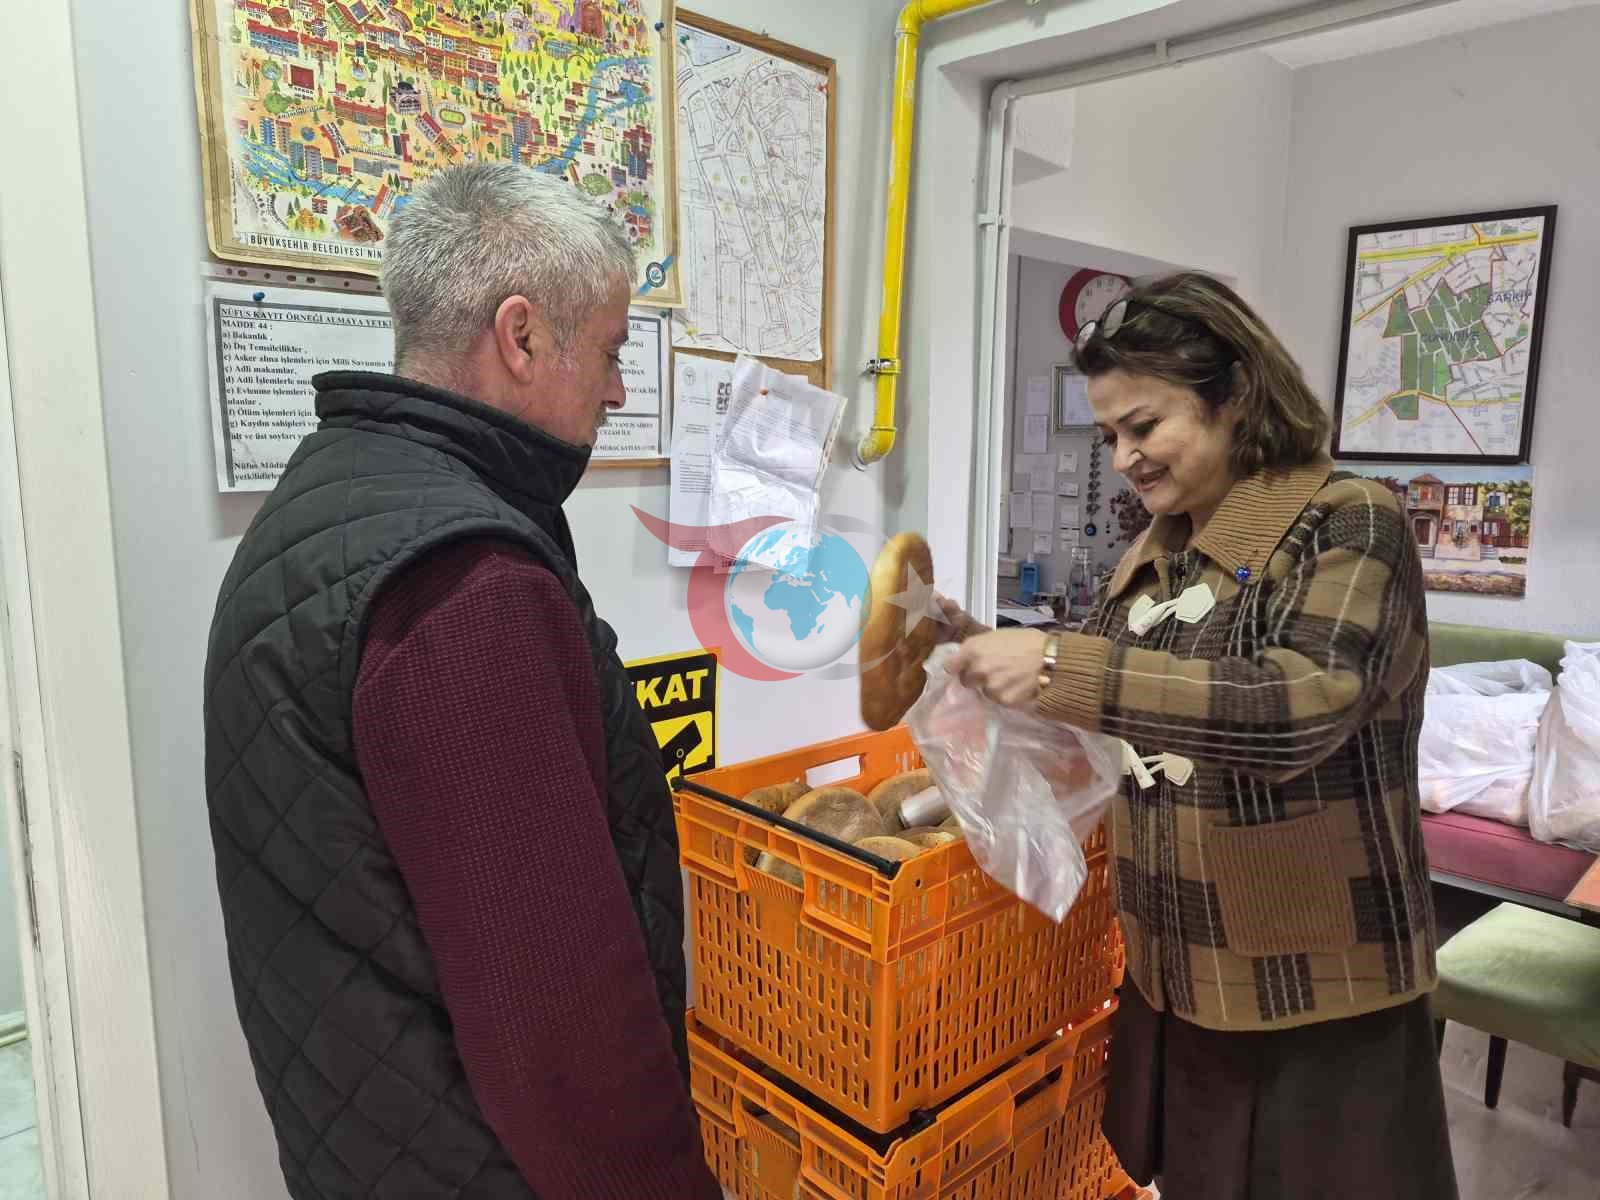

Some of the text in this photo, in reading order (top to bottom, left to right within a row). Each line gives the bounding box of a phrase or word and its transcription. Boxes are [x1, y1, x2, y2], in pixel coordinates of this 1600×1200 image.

[253, 310, 283, 320] KAYIT
[222, 319, 256, 329] MADDE
[234, 353, 256, 362] Asker
[636, 668, 709, 709] KAT
